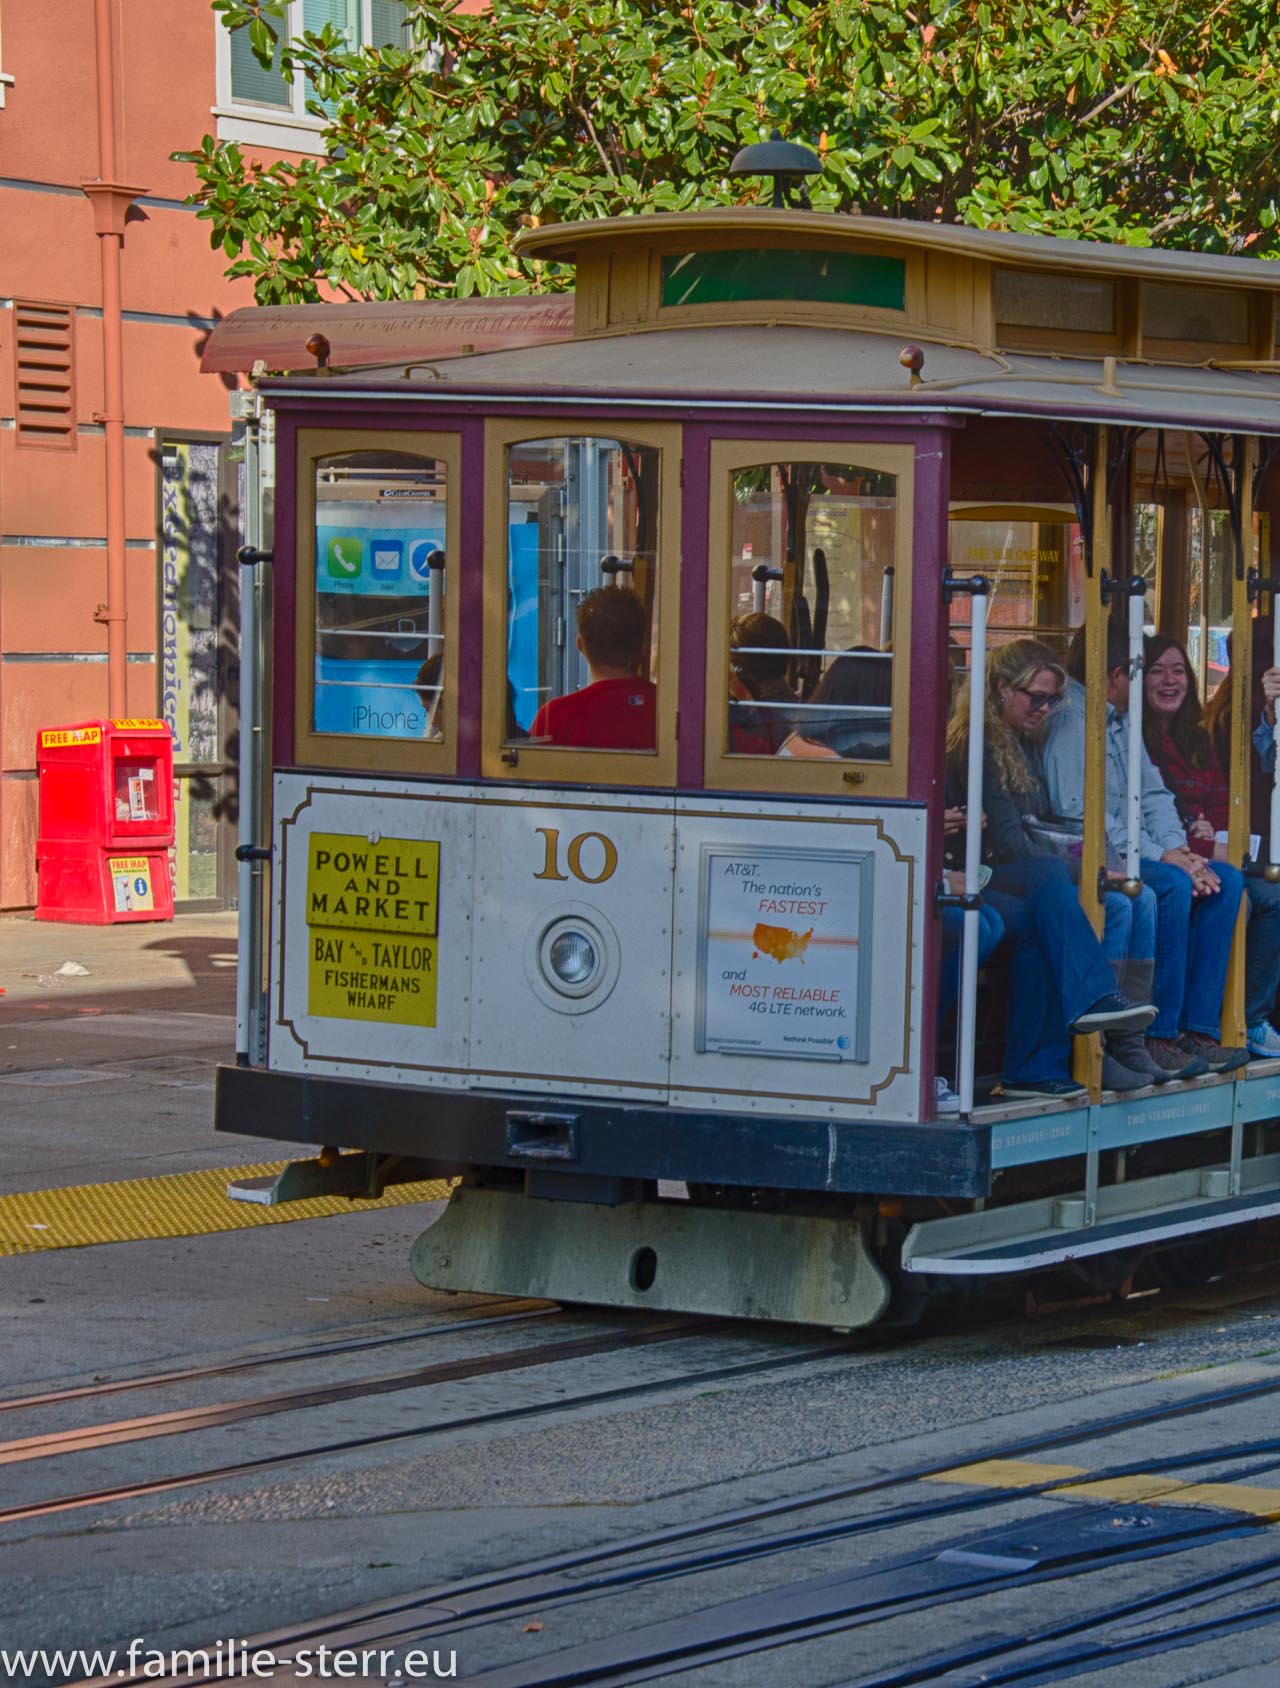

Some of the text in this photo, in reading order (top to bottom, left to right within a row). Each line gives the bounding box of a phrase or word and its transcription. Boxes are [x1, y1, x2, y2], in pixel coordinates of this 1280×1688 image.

[1038, 549, 1061, 563] WAY
[113, 719, 136, 728] FREE
[352, 704, 418, 730] iPhone
[44, 730, 98, 745] FREE MAP
[112, 859, 147, 869] FREE MAP
[316, 850, 429, 879] POWELL
[533, 827, 618, 884] 10
[724, 863, 761, 877] AT&T.
[344, 877, 400, 896] AND
[742, 880, 822, 897] The nation's
[311, 893, 430, 921] MARKET
[758, 899, 828, 915] FASTEST
[315, 937, 344, 963] BAY
[372, 942, 433, 971] TAYLOR
[324, 969, 421, 994] FISHERMANS
[721, 969, 747, 981] and
[347, 991, 397, 1011] WHARF
[729, 984, 841, 1002] MOST RELIABLE
[748, 1001, 847, 1019] 4G LTE network.
[783, 1035, 806, 1043] Rethink
